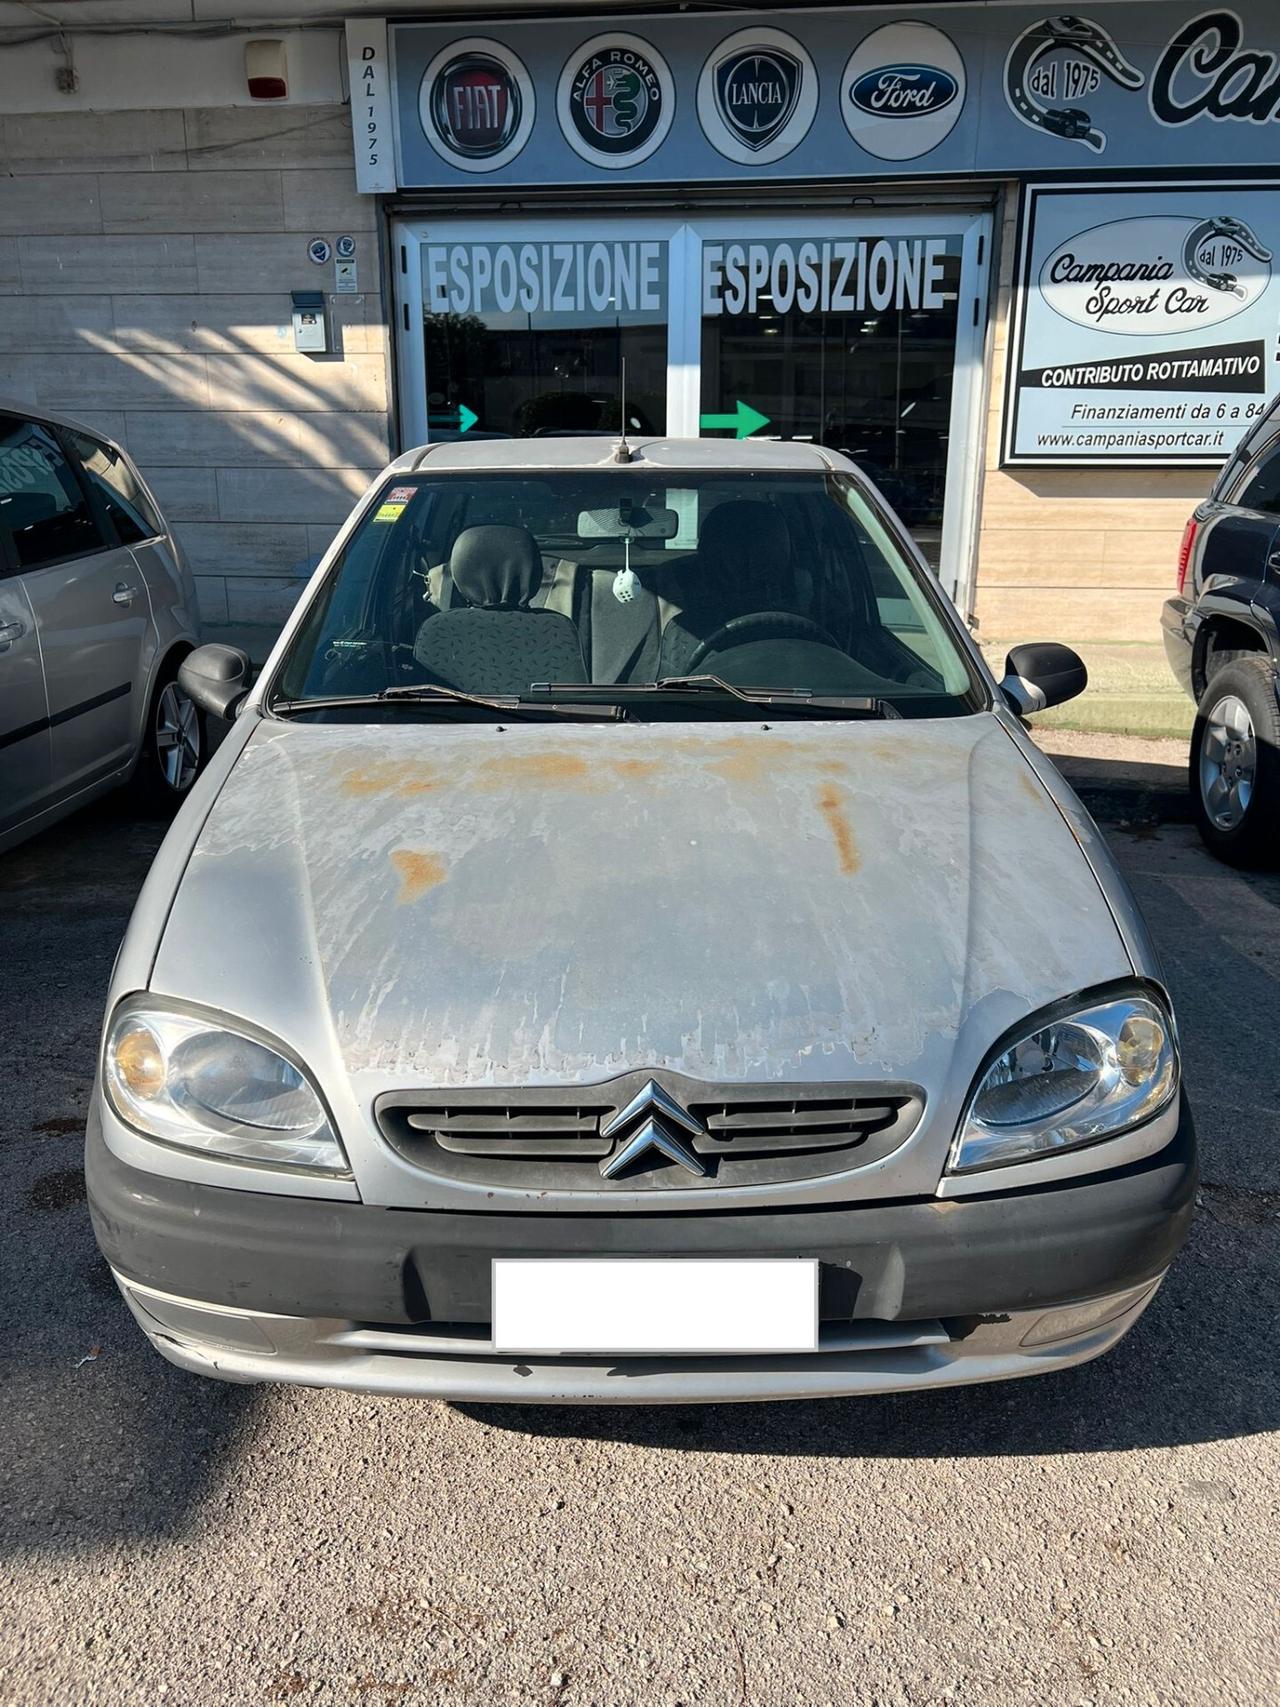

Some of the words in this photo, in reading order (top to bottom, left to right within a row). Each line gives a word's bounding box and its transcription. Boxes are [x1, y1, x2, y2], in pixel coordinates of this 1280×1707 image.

[362, 46, 376, 97] DAL
[573, 58, 602, 102] ALFA
[610, 51, 660, 101] ROMEO
[1031, 63, 1056, 98] dal
[1064, 61, 1099, 99] 1975
[453, 85, 501, 130] FIAT
[732, 82, 782, 105] LANCIA
[871, 73, 936, 108] Ford
[367, 106, 378, 165] 1975
[1050, 253, 1174, 290] Campania
[1200, 248, 1215, 267] dal
[1220, 245, 1243, 268] 1975
[427, 242, 662, 314] ESPOSIZIONE
[703, 239, 946, 315] ESPOSIZIONE
[1085, 286, 1160, 322] Sport
[1165, 287, 1209, 314] Car
[1041, 364, 1144, 387] CONTRIBUTO
[1147, 355, 1261, 381] ROTTAMATIVO
[1071, 403, 1187, 420] Finanziamenti
[1190, 403, 1211, 419] da
[1216, 403, 1227, 419] 6
[1230, 407, 1240, 419] a
[1245, 402, 1266, 418] 84
[1037, 430, 1224, 450] www.campaniasportcar.it
